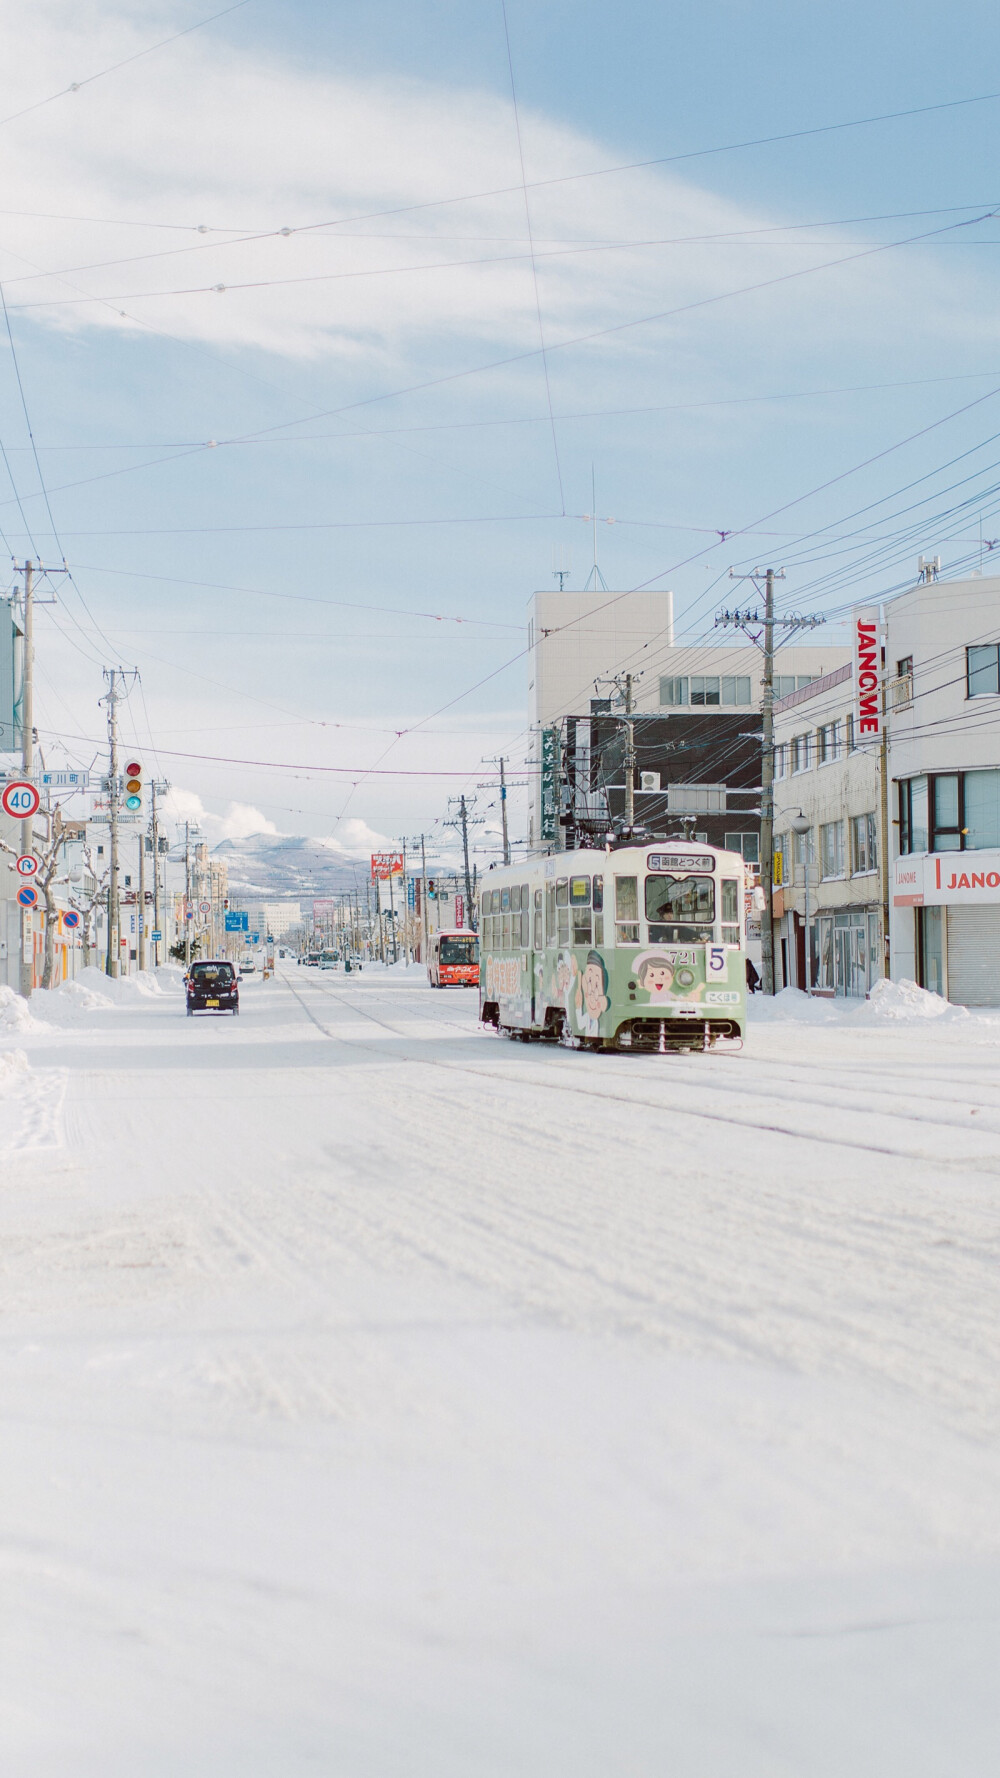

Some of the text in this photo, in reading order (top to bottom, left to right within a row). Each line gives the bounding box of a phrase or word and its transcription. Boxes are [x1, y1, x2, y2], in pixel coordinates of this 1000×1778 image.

[857, 617, 879, 734] JANOME
[10, 791, 32, 808] 40
[652, 856, 661, 869] 5
[898, 872, 917, 885] JANOME
[669, 951, 698, 965] 721
[709, 947, 724, 971] 5
